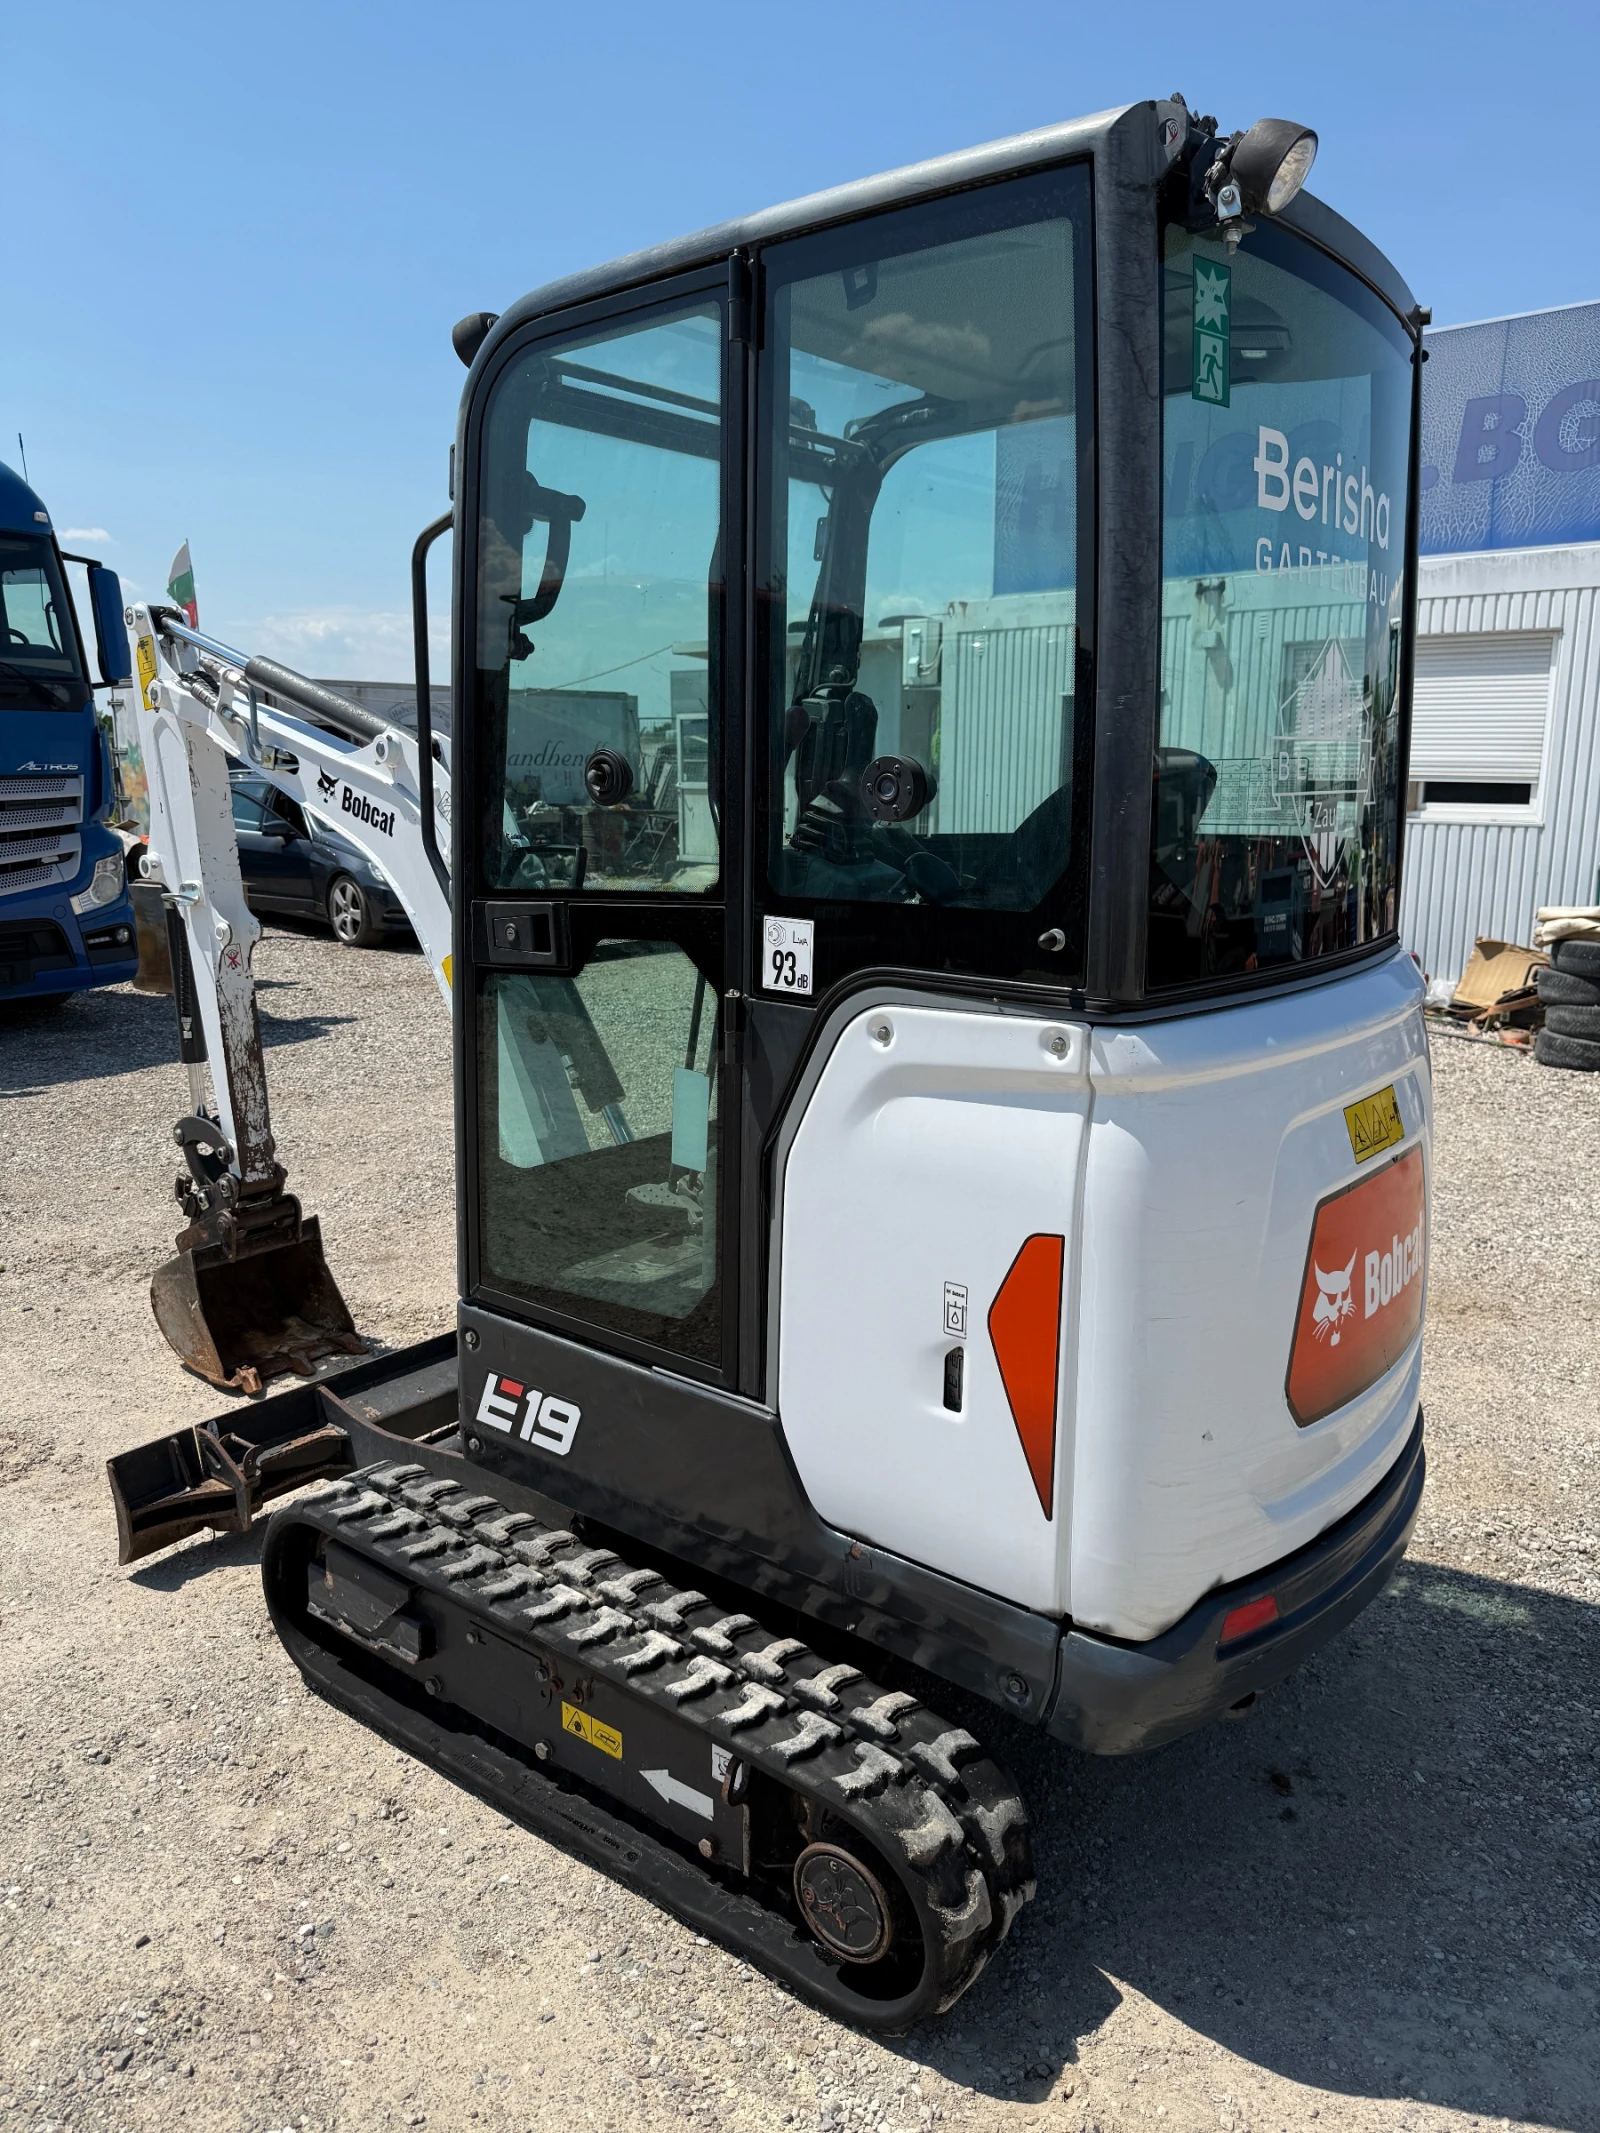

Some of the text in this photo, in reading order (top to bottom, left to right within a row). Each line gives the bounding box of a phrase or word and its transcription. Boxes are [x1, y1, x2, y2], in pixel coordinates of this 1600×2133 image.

[1254, 425, 1391, 550] Berisha
[1255, 537, 1388, 607] GARTENBAU
[17, 760, 79, 771] ACTROS
[341, 785, 395, 838] Bobcat
[772, 949, 809, 989] 93 dB
[1364, 1210, 1423, 1319] Bobcat
[476, 1372, 582, 1456] E19
